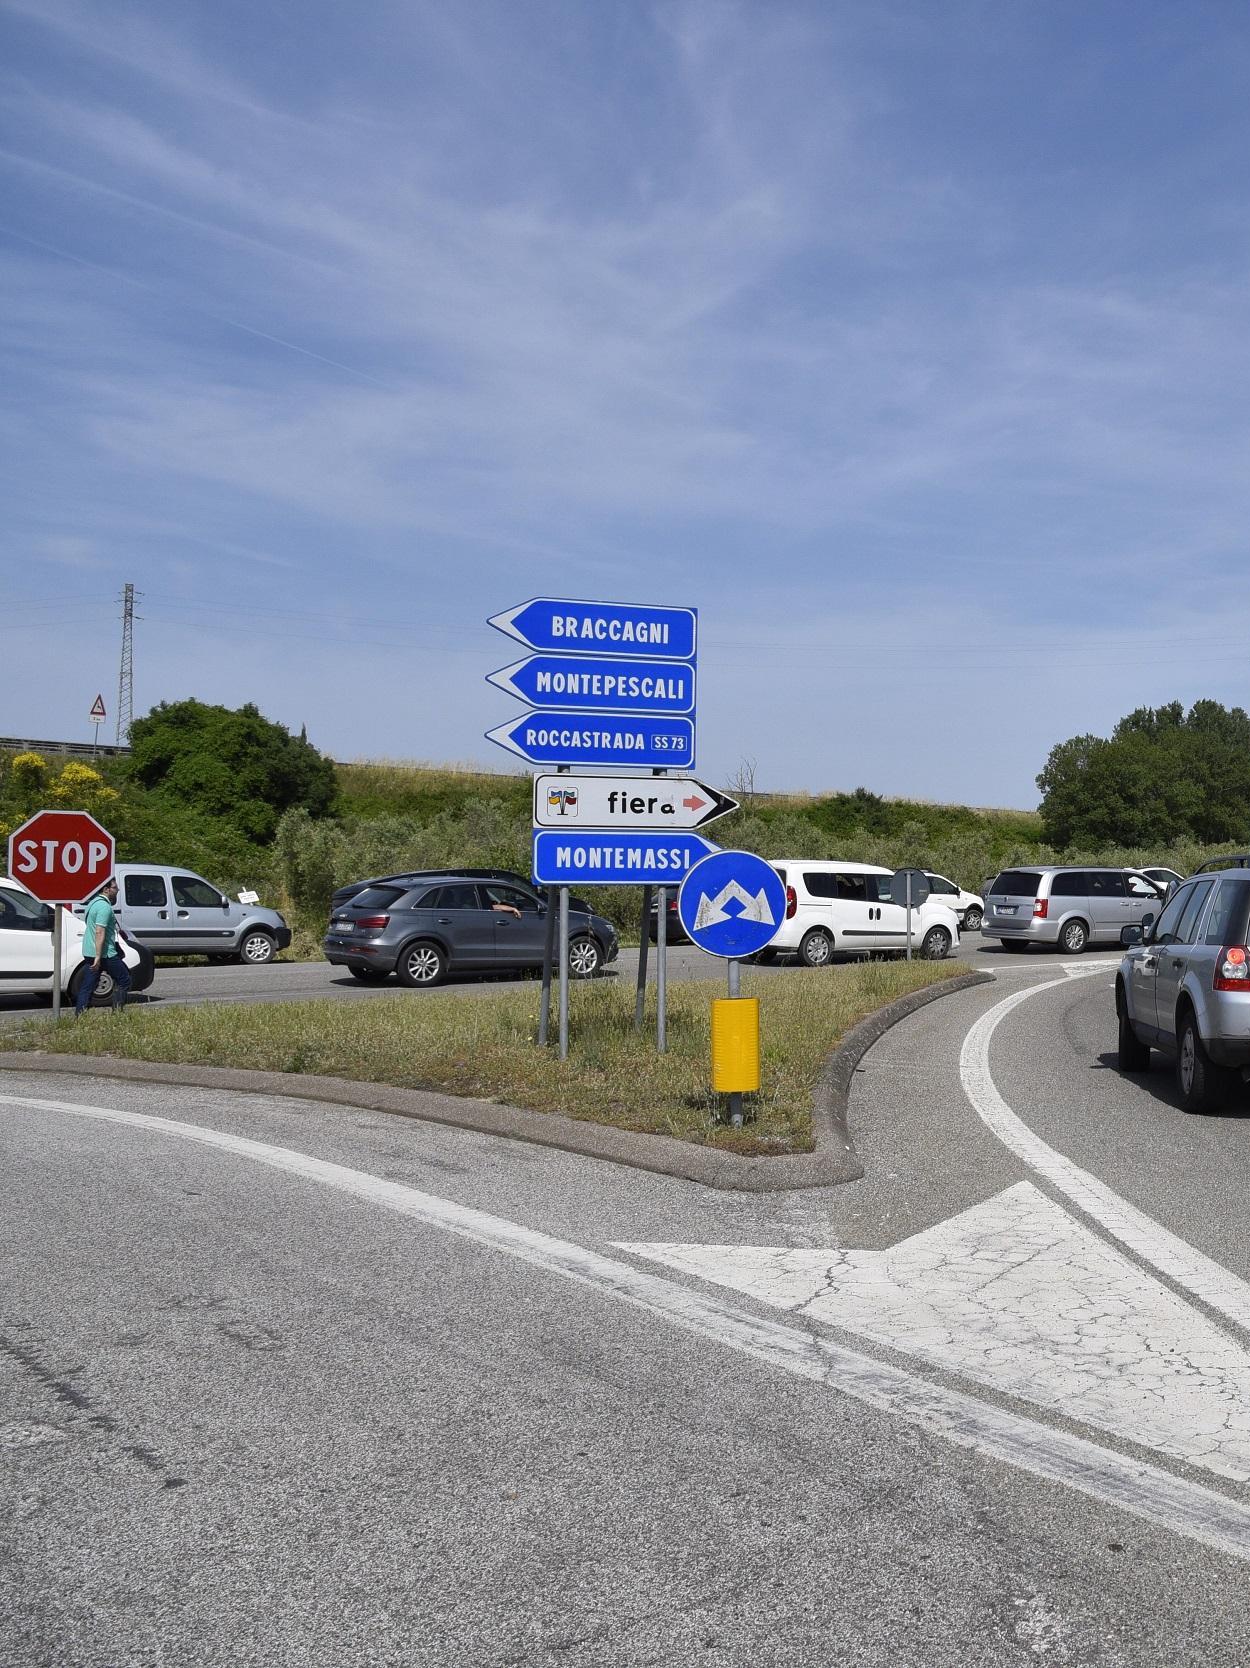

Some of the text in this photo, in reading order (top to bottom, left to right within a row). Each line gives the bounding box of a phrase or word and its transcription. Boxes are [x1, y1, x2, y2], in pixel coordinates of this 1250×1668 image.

[551, 615, 669, 645] BRACCAGNI
[536, 671, 684, 699] MONTEPESCALI
[526, 729, 645, 750] ROCCASTRADA
[654, 736, 684, 749] SS 73
[607, 791, 675, 815] fiera
[17, 839, 108, 874] STOP
[555, 847, 690, 869] MONTEMASSI
